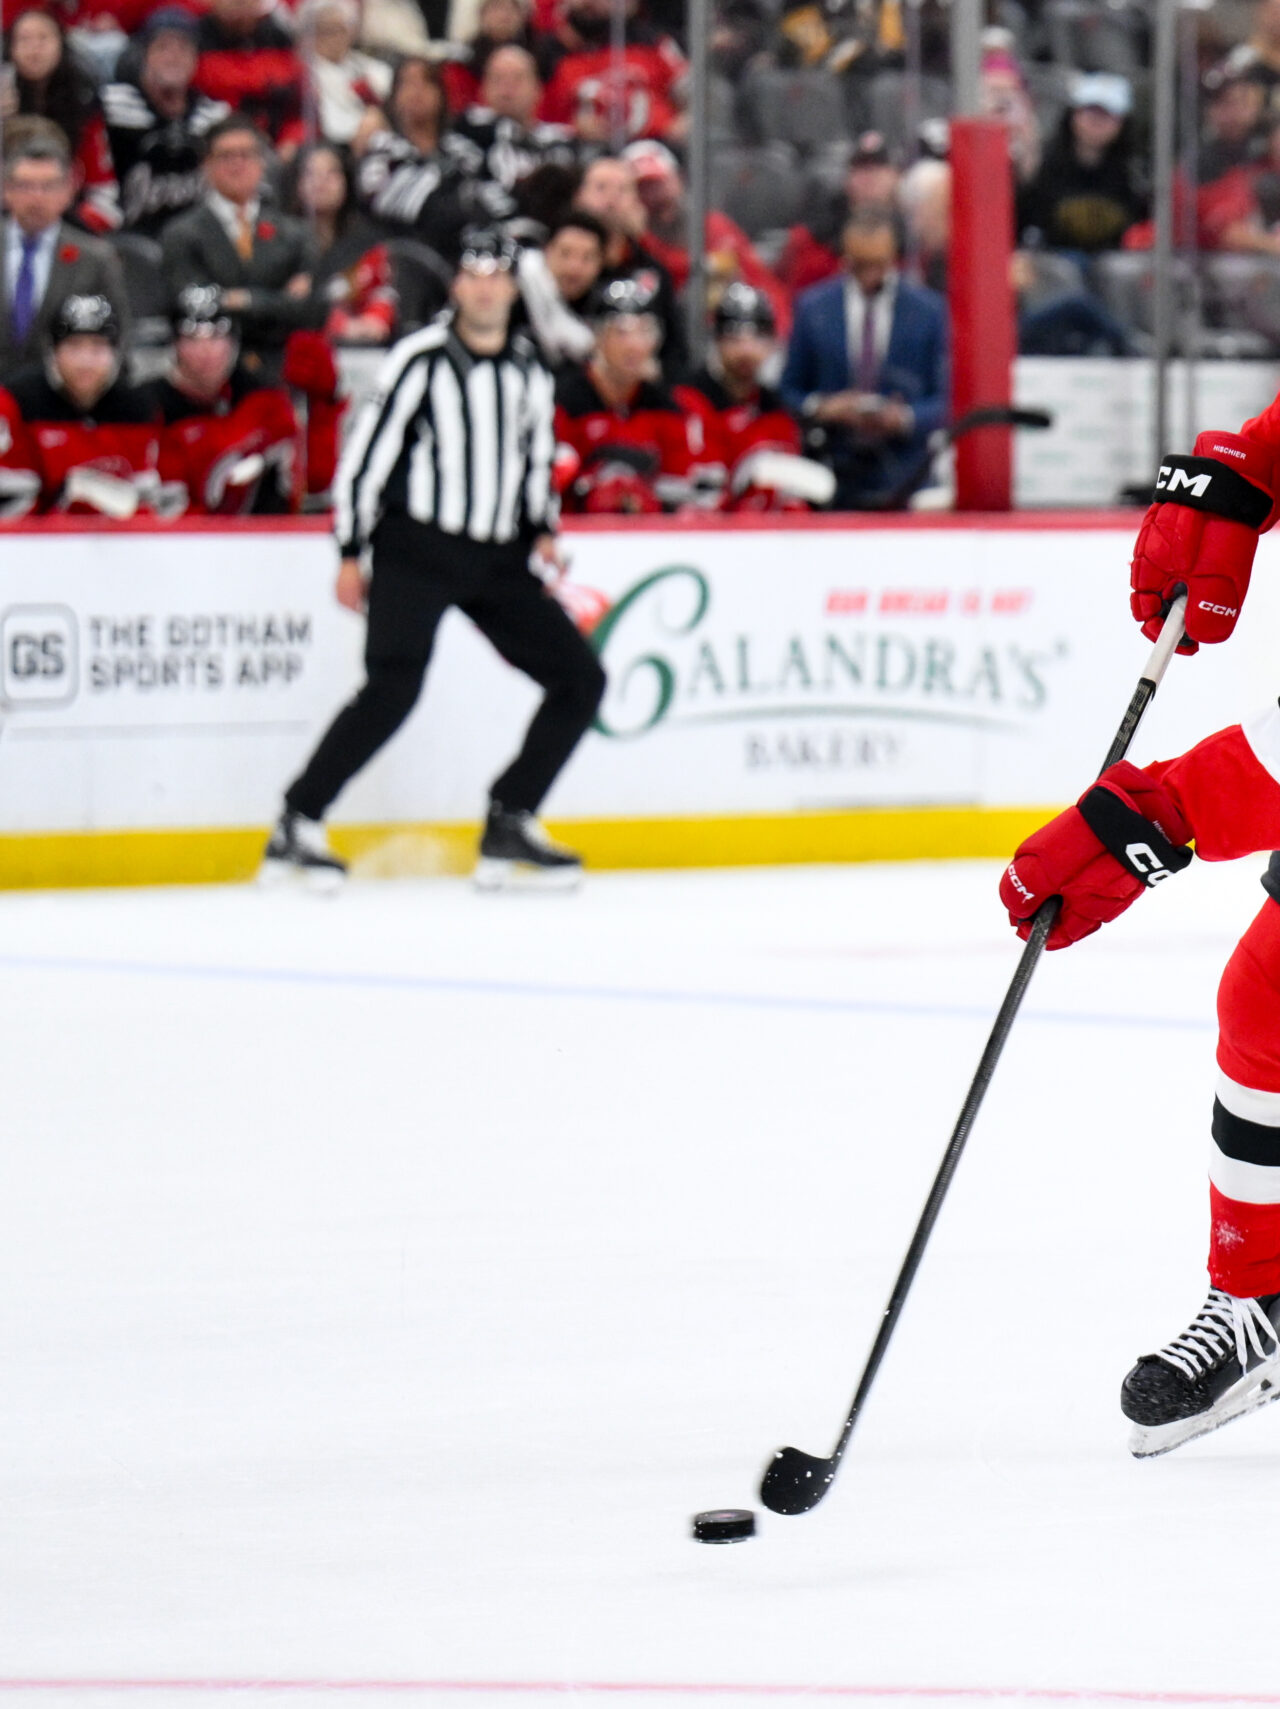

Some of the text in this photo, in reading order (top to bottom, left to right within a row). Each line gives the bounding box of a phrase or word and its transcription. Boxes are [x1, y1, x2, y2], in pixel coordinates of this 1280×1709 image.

[1213, 444, 1247, 460] HISCHIER
[1198, 600, 1237, 618] CCM
[89, 613, 313, 646] THE GOTHAM
[10, 633, 65, 679] GS
[89, 651, 304, 691] SPORTS APP
[1007, 864, 1035, 904] CCM
